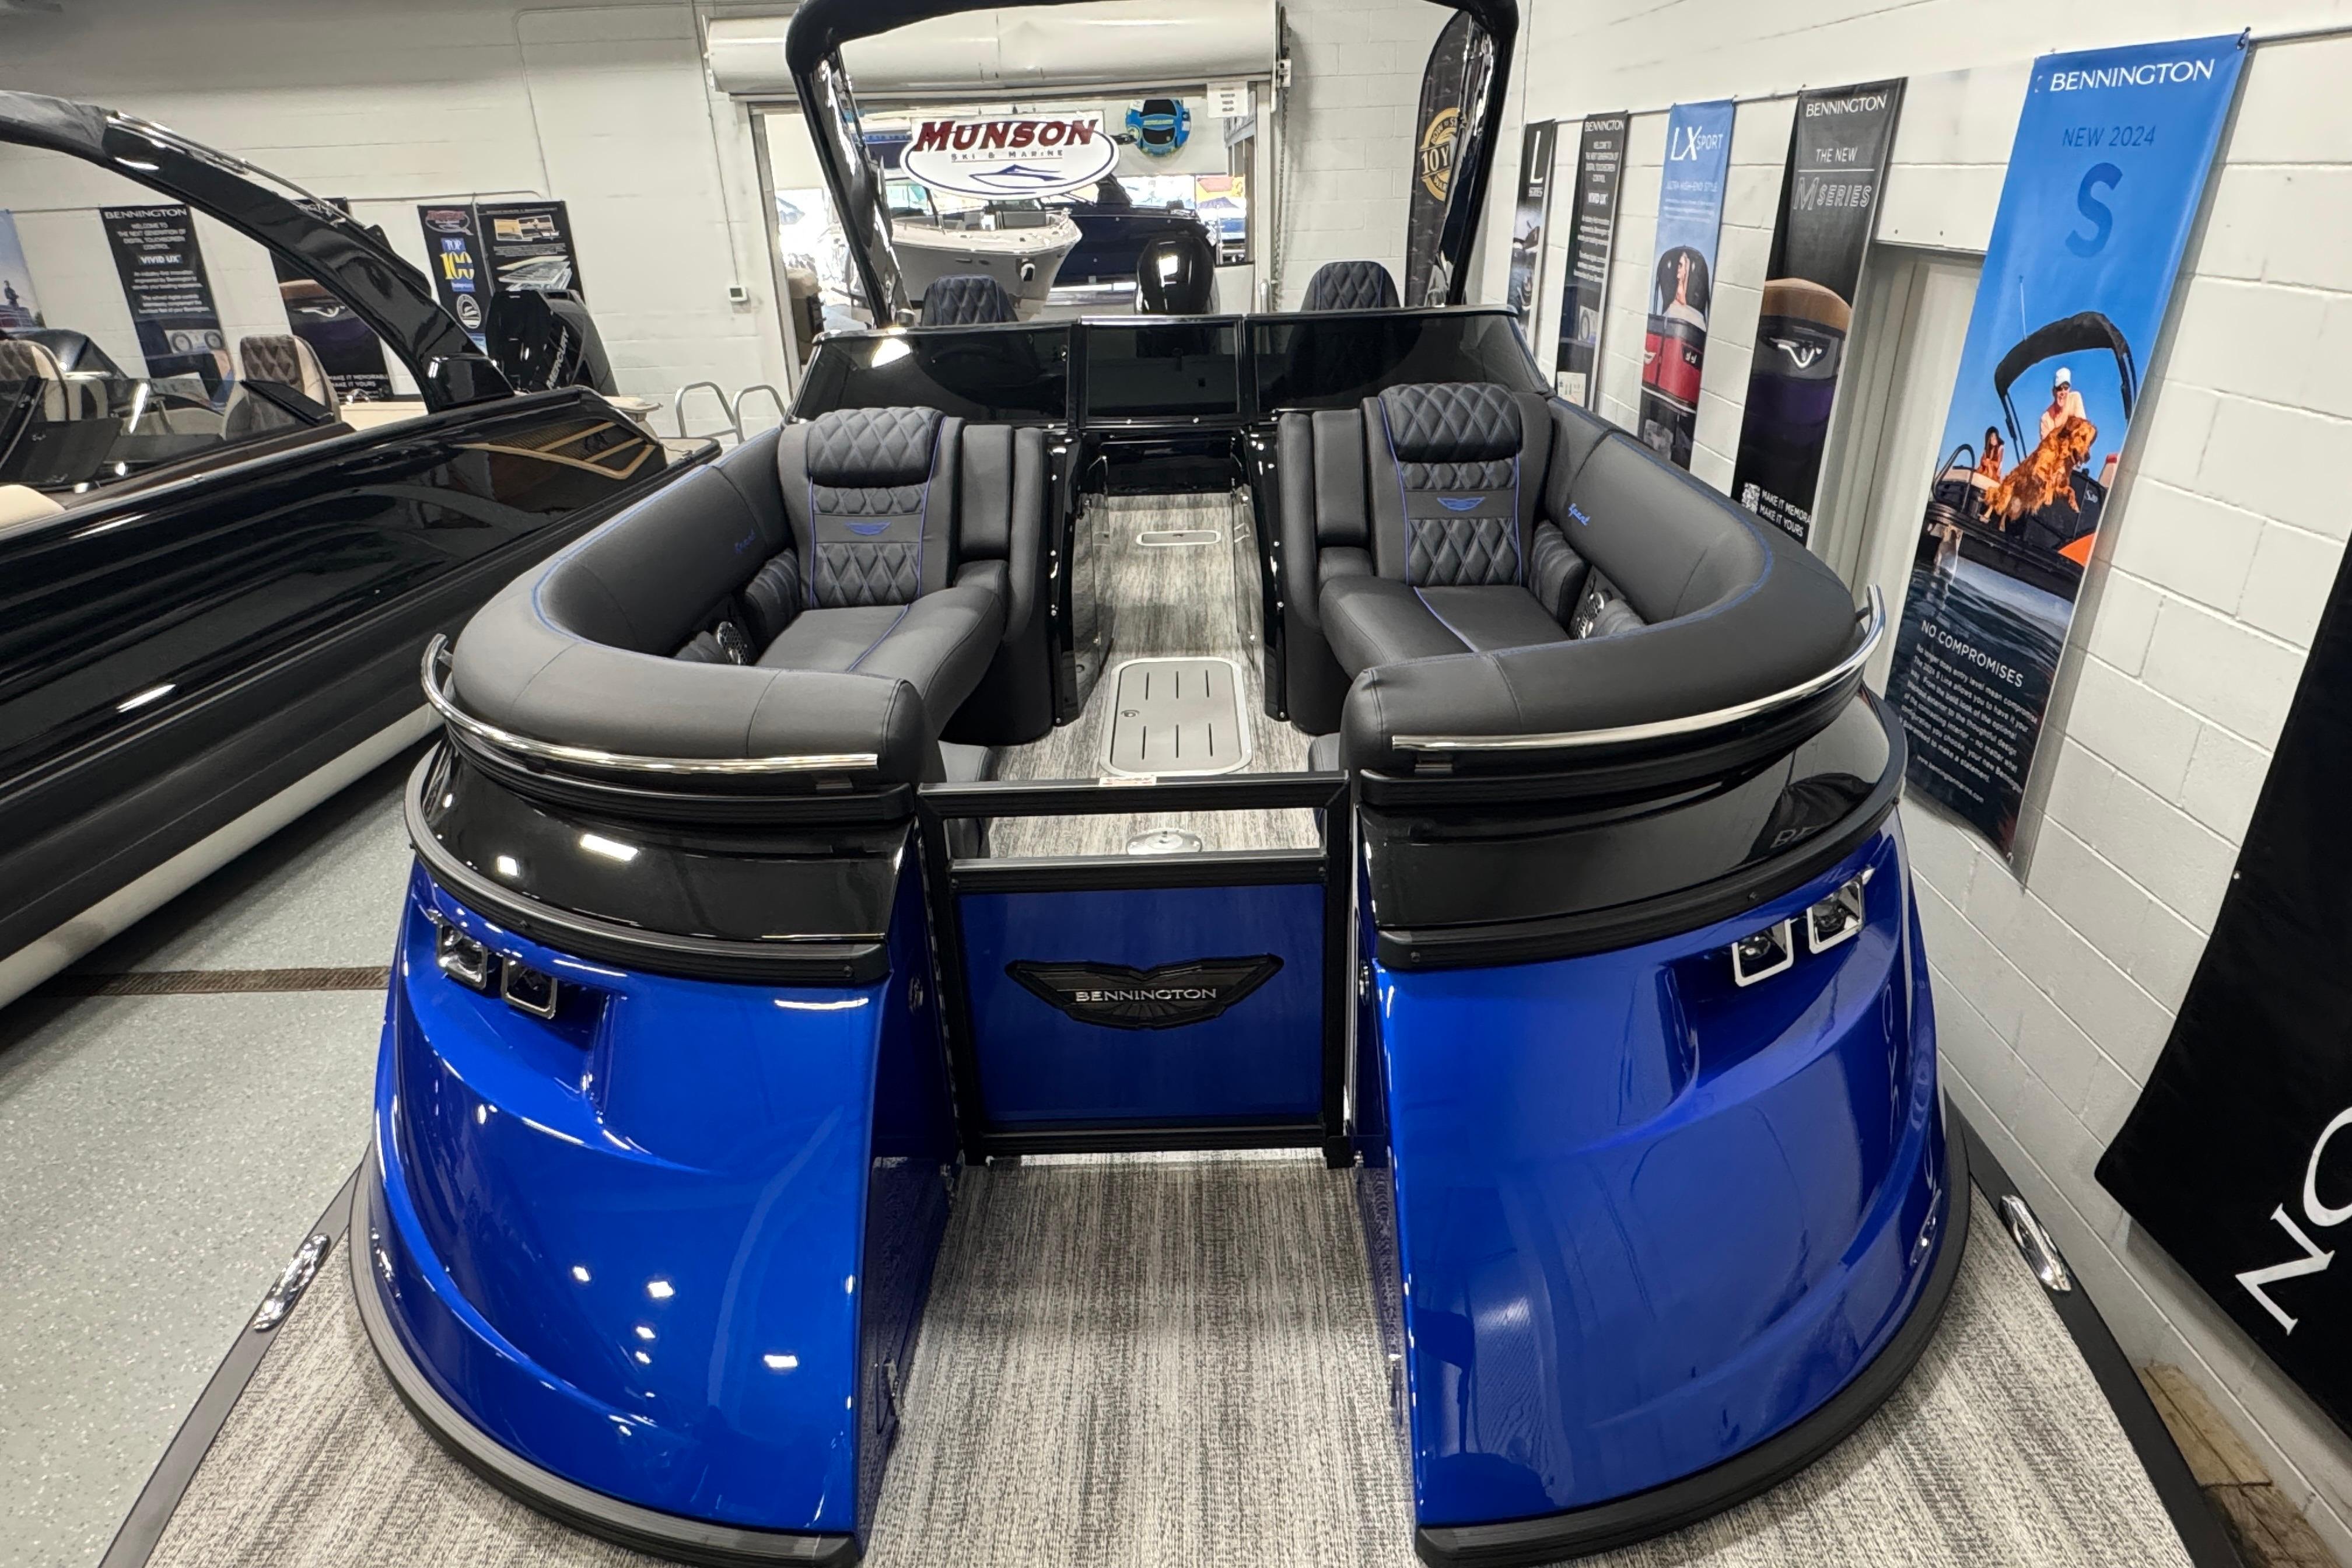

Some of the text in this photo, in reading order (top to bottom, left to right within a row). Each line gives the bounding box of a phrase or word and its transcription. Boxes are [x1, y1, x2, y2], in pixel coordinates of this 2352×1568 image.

[2049, 58, 2216, 92] BENNINGTON
[1806, 94, 1887, 117] BENNINGTON
[912, 118, 1098, 152] MUNSON
[1584, 120, 1624, 132] BENNINGTON
[2063, 125, 2156, 147] NEW 2024
[1009, 149, 1063, 158] MARINE
[1530, 131, 1544, 184] L
[1670, 125, 1723, 161] LX SPORT
[1816, 147, 1858, 163] THE NEW
[1421, 148, 1439, 174] 10
[1793, 176, 1872, 211] M SERIES
[104, 208, 187, 219] BENNINGTON
[2065, 162, 2123, 258] S
[444, 239, 461, 251] TOP
[140, 256, 164, 264] VIVID
[440, 251, 475, 280] 100
[546, 326, 569, 390] MERCURY
[1762, 489, 1779, 506] MAKE
[1779, 498, 1785, 510] IT
[1760, 504, 1803, 537] MAKE IT YOURS
[1922, 620, 2024, 687] NO COMPROMISES
[1953, 668, 1969, 683] entry
[1969, 677, 1985, 690] level
[1985, 687, 2003, 701] mean
[1953, 684, 1972, 699] allows
[1973, 695, 1985, 706] you
[1986, 701, 1993, 710] to
[1994, 705, 2009, 720] have
[2015, 720, 2029, 733] your
[1959, 700, 1972, 713] look
[1948, 708, 1955, 717] to
[1956, 712, 1966, 723] the
[1966, 719, 1997, 743] thoughtful
[1074, 988, 1217, 1002] BENNINGTON
